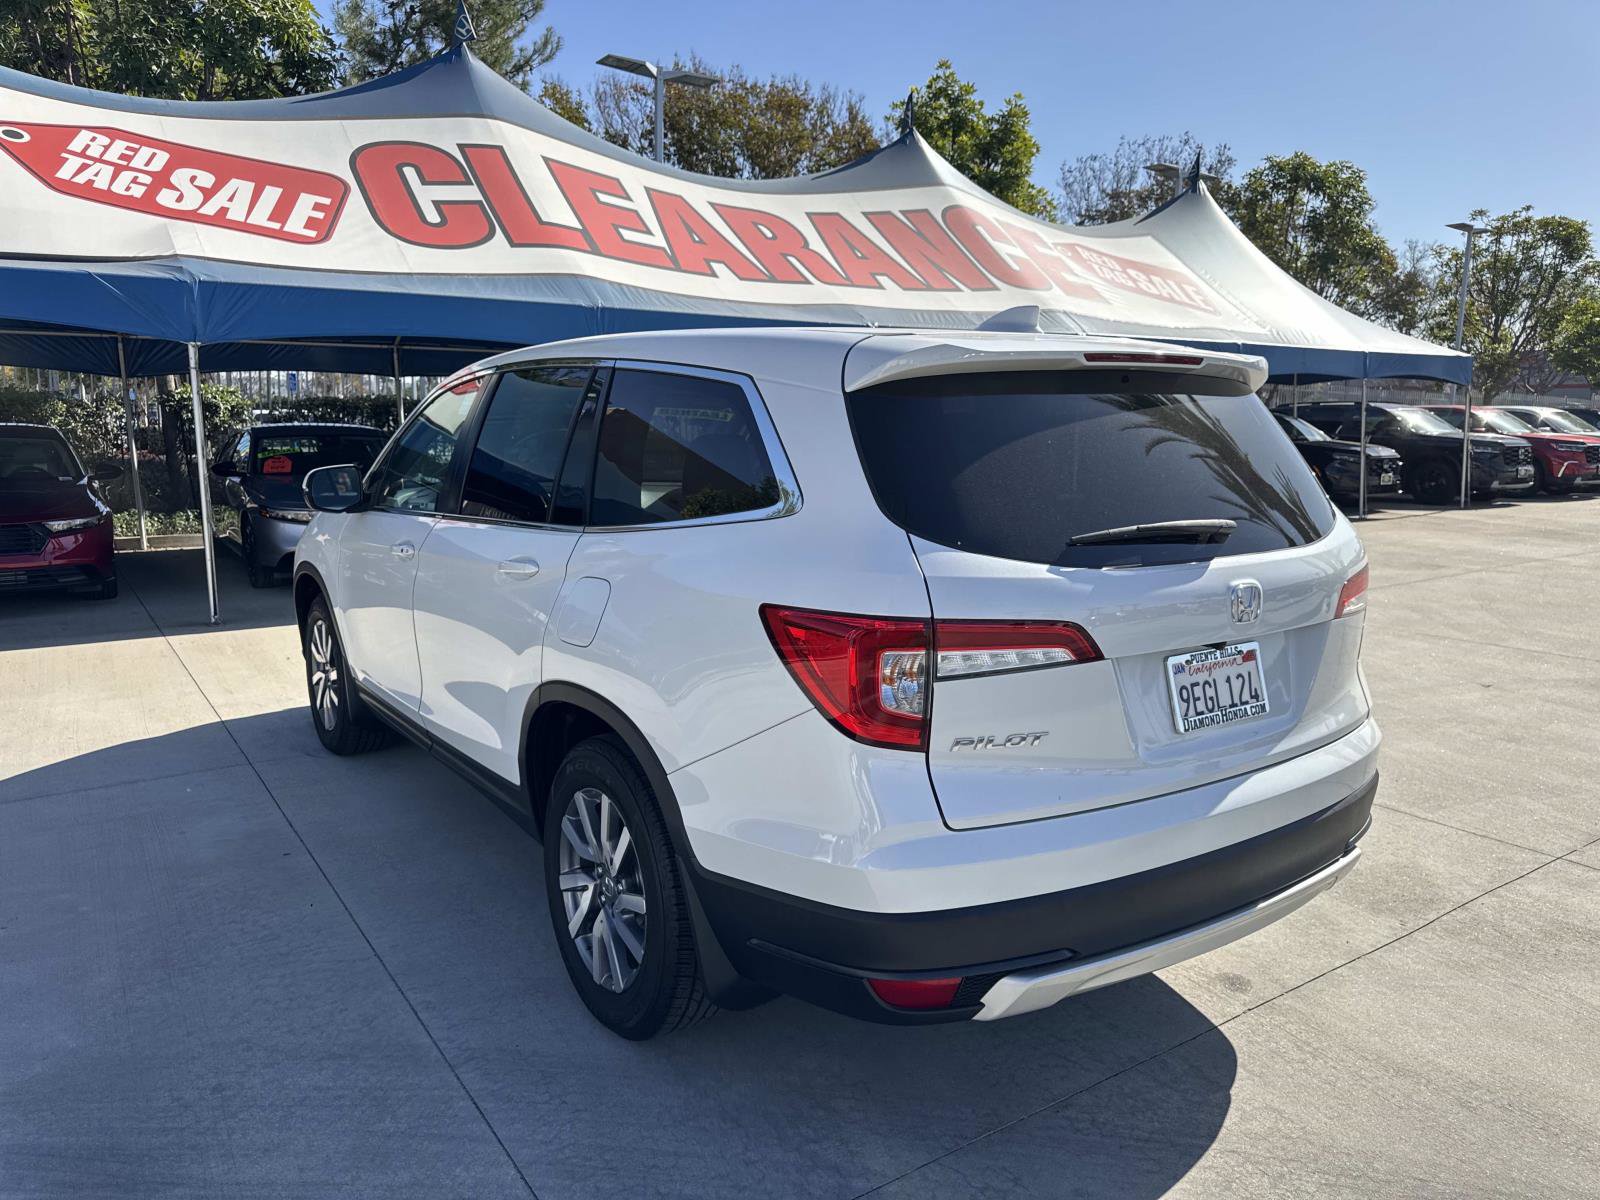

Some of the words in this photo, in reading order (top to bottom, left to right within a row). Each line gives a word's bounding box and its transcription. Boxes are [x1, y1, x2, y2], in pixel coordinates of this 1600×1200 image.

[66, 129, 171, 172] RED
[54, 152, 153, 199] TAG
[155, 167, 333, 238] SALE
[348, 140, 1103, 302] CLEARANCE
[1075, 246, 1123, 272] RED
[1086, 261, 1136, 288] TAG
[1126, 268, 1217, 314] SALE
[1188, 657, 1241, 677] California
[1190, 649, 1218, 663] PUENTE
[1219, 646, 1239, 659] HILLS
[1179, 671, 1260, 718] 9EGL124
[949, 731, 1050, 752] PILOT
